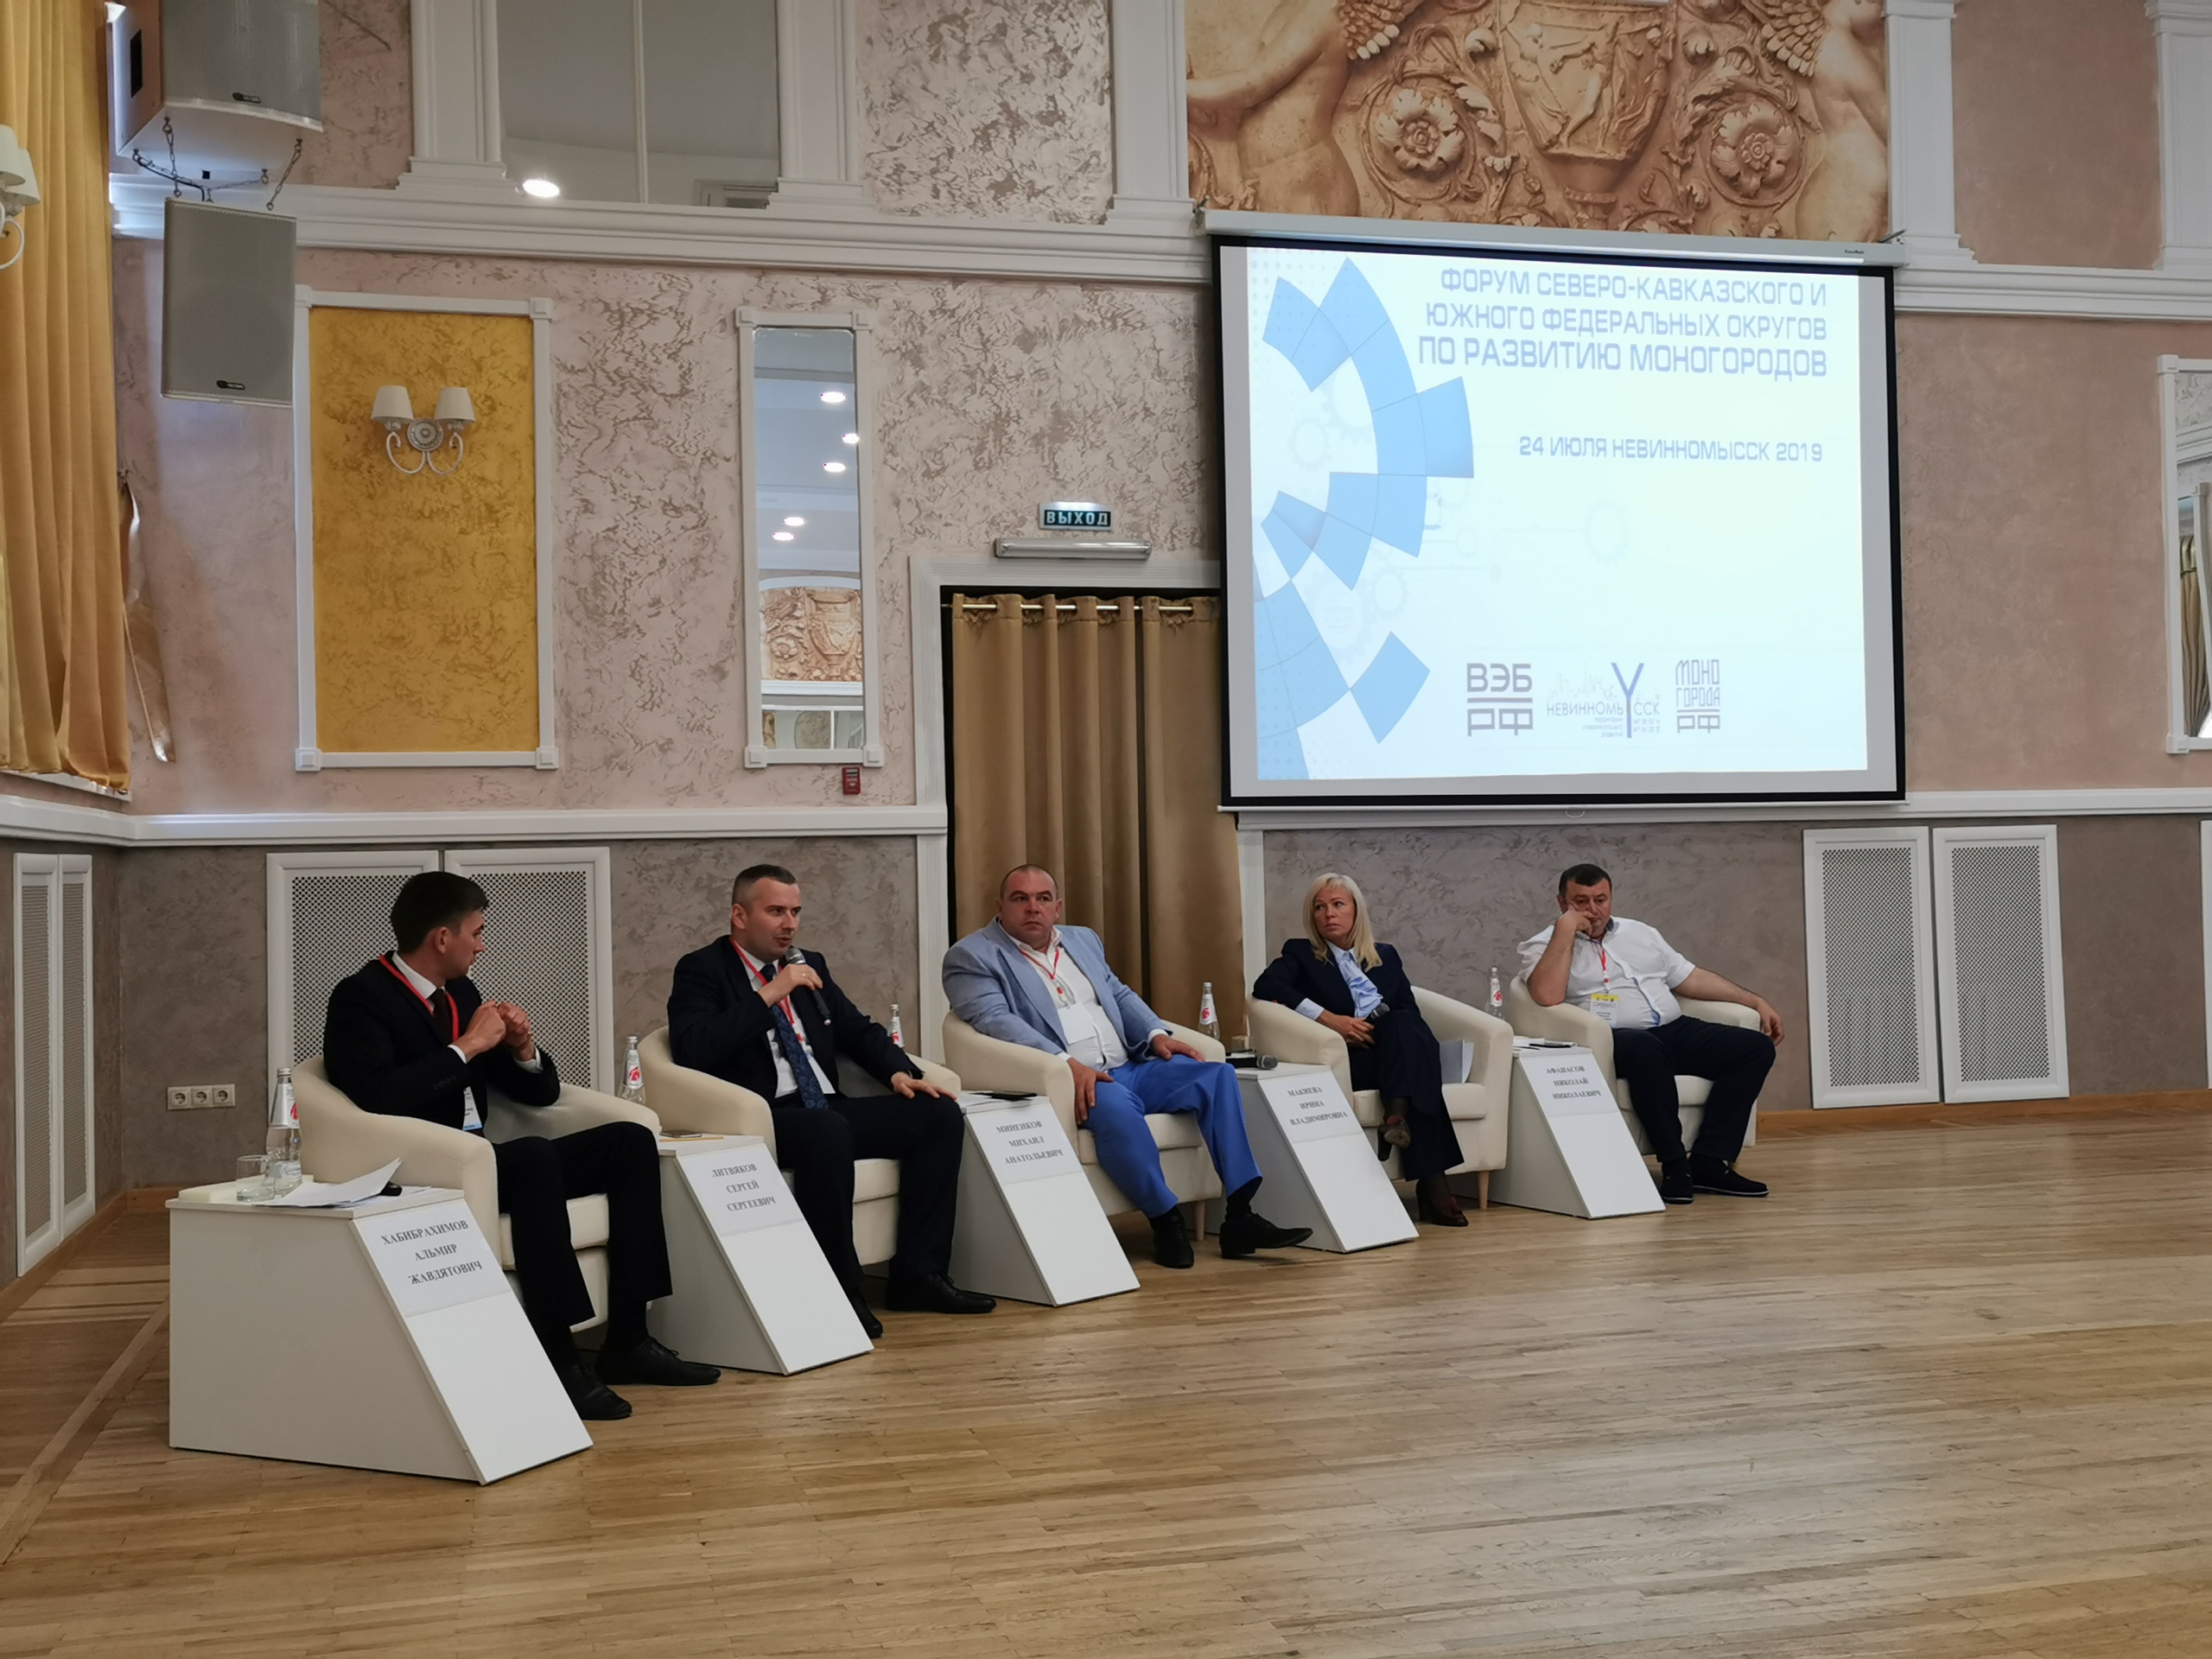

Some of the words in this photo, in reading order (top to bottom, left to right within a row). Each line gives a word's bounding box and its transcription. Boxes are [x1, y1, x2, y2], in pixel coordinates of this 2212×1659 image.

[1441, 268, 1529, 295] ФОРУМ
[1537, 272, 1803, 305] СЕВЕРО-КАВКАЗСКОГО
[1811, 283, 1827, 306] И
[1427, 302, 1535, 330] ЮЖНОГО
[1542, 308, 1720, 337] ФЕДЕРАЛЬНЫХ
[1727, 315, 1827, 340] ОКРУГОВ
[1419, 336, 1455, 365] ПО
[1465, 338, 1621, 370] РАЗВИТИЮ
[1630, 344, 1827, 381] МОНОГОРОДОВ
[1519, 435, 1544, 456] 24
[1550, 436, 1606, 457] ИЮЛЯ
[1612, 438, 1770, 461] НЕВИННОМЫССК
[1776, 442, 1822, 462] 2019
[1046, 511, 1109, 525] ВЫХОД
[1466, 663, 1533, 693] ВЭБ
[1675, 658, 1720, 685] МОНО
[1675, 687, 1720, 708] ГОРОДА
[1467, 708, 1534, 737] РФ
[1676, 714, 1720, 734] РФ
[1554, 1077, 1589, 1086] НИКОЛАЙ
[1552, 1090, 1602, 1099] НИКОЛАЕВИЧ
[1299, 1100, 1325, 1109] ИРИНА
[1289, 1111, 1349, 1125] ВЛАДИМИРОВНА
[995, 1121, 1043, 1134] МИНЕНКОВ
[1008, 1136, 1045, 1147] МИХАИЛ
[1005, 1148, 1064, 1164] АНАТОЛЬЕВИЧ
[712, 1164, 757, 1178] ЛИТВЯКОВ
[726, 1180, 760, 1193] СЕРГЕЙ
[727, 1196, 777, 1211] СЕРГЕЕВИЧ
[381, 1220, 469, 1245] ХАБИБРАХИМОВ
[415, 1243, 458, 1261] АЛЬМИР
[408, 1260, 483, 1285] ЖАВДЯТОВИЧ
